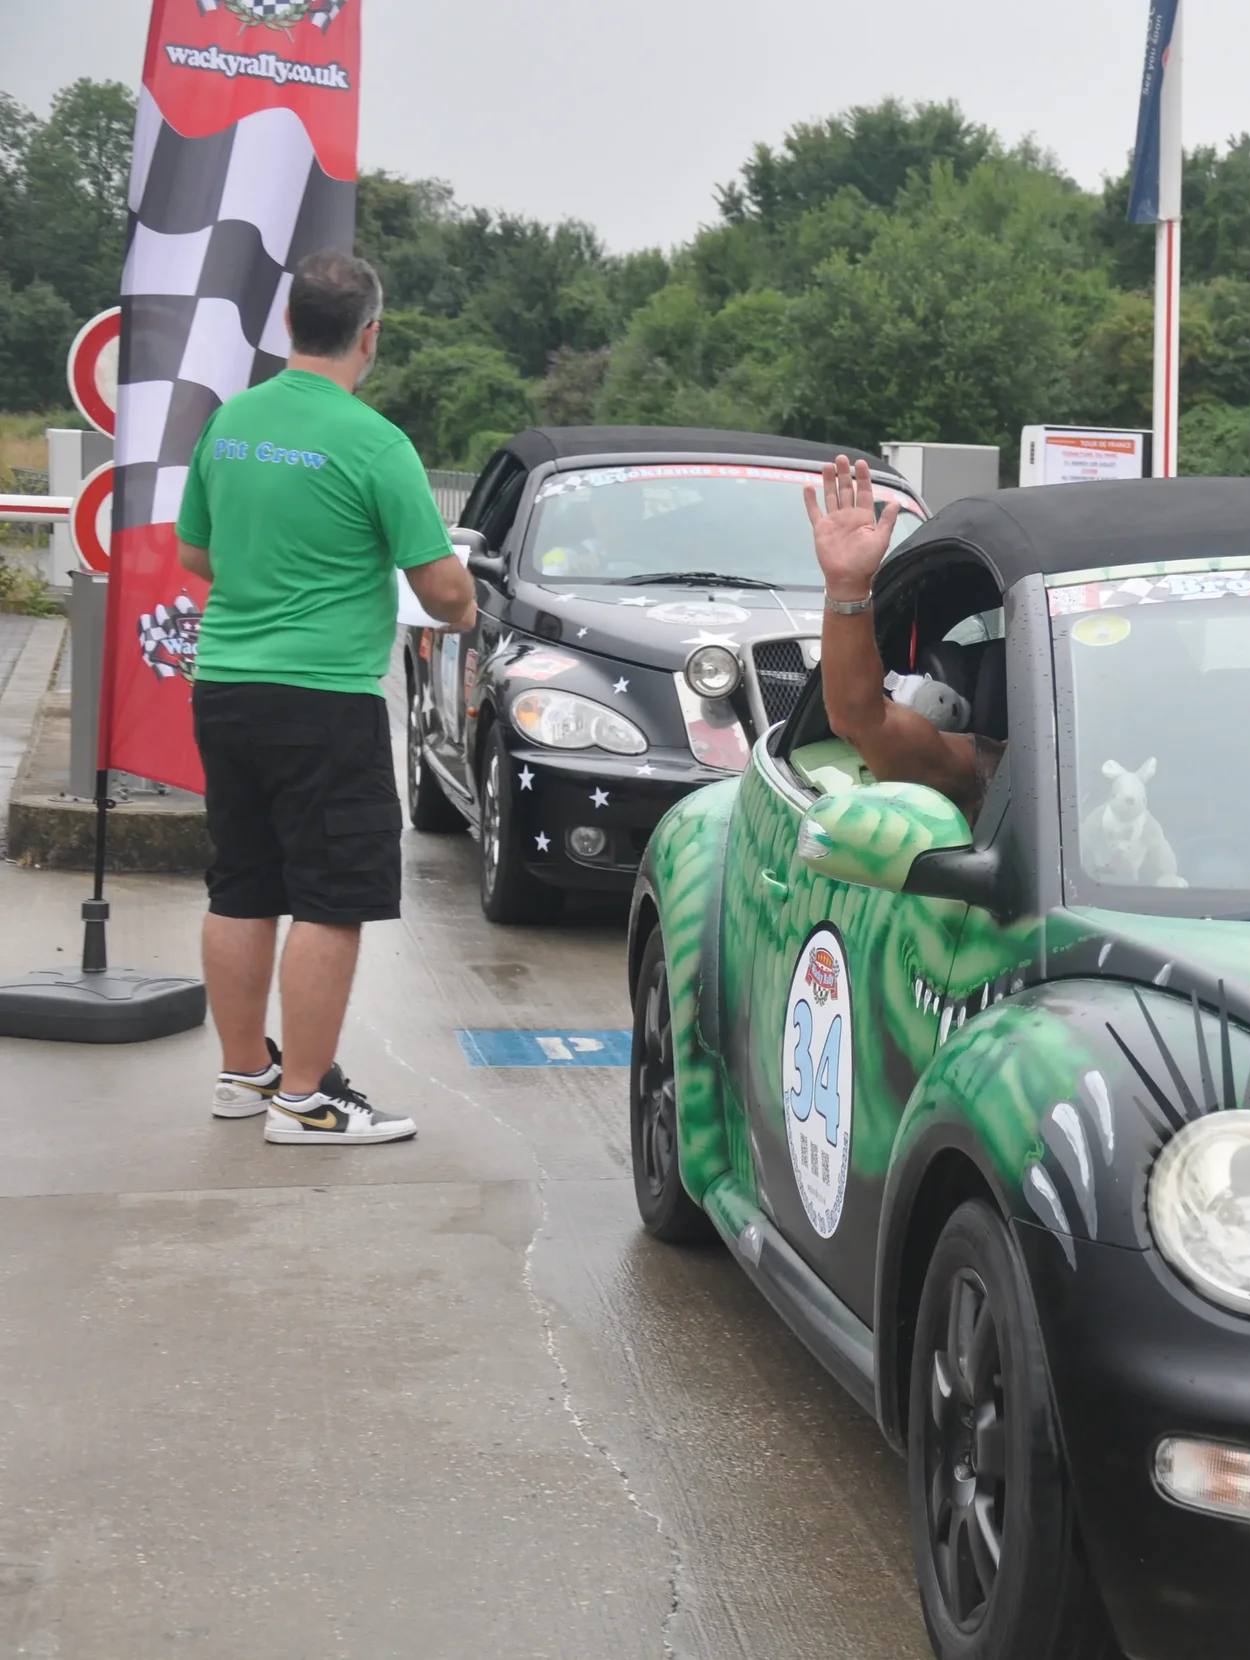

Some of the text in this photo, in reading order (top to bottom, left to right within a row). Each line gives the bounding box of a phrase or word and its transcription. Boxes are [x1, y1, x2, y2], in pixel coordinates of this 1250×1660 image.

[165, 46, 349, 89] wackyrally.co.uk
[1147, 47, 1156, 70] you
[213, 438, 328, 469] Pit Crew
[718, 467, 738, 476] to
[161, 637, 198, 655] Wac
[790, 998, 842, 1148] 34
